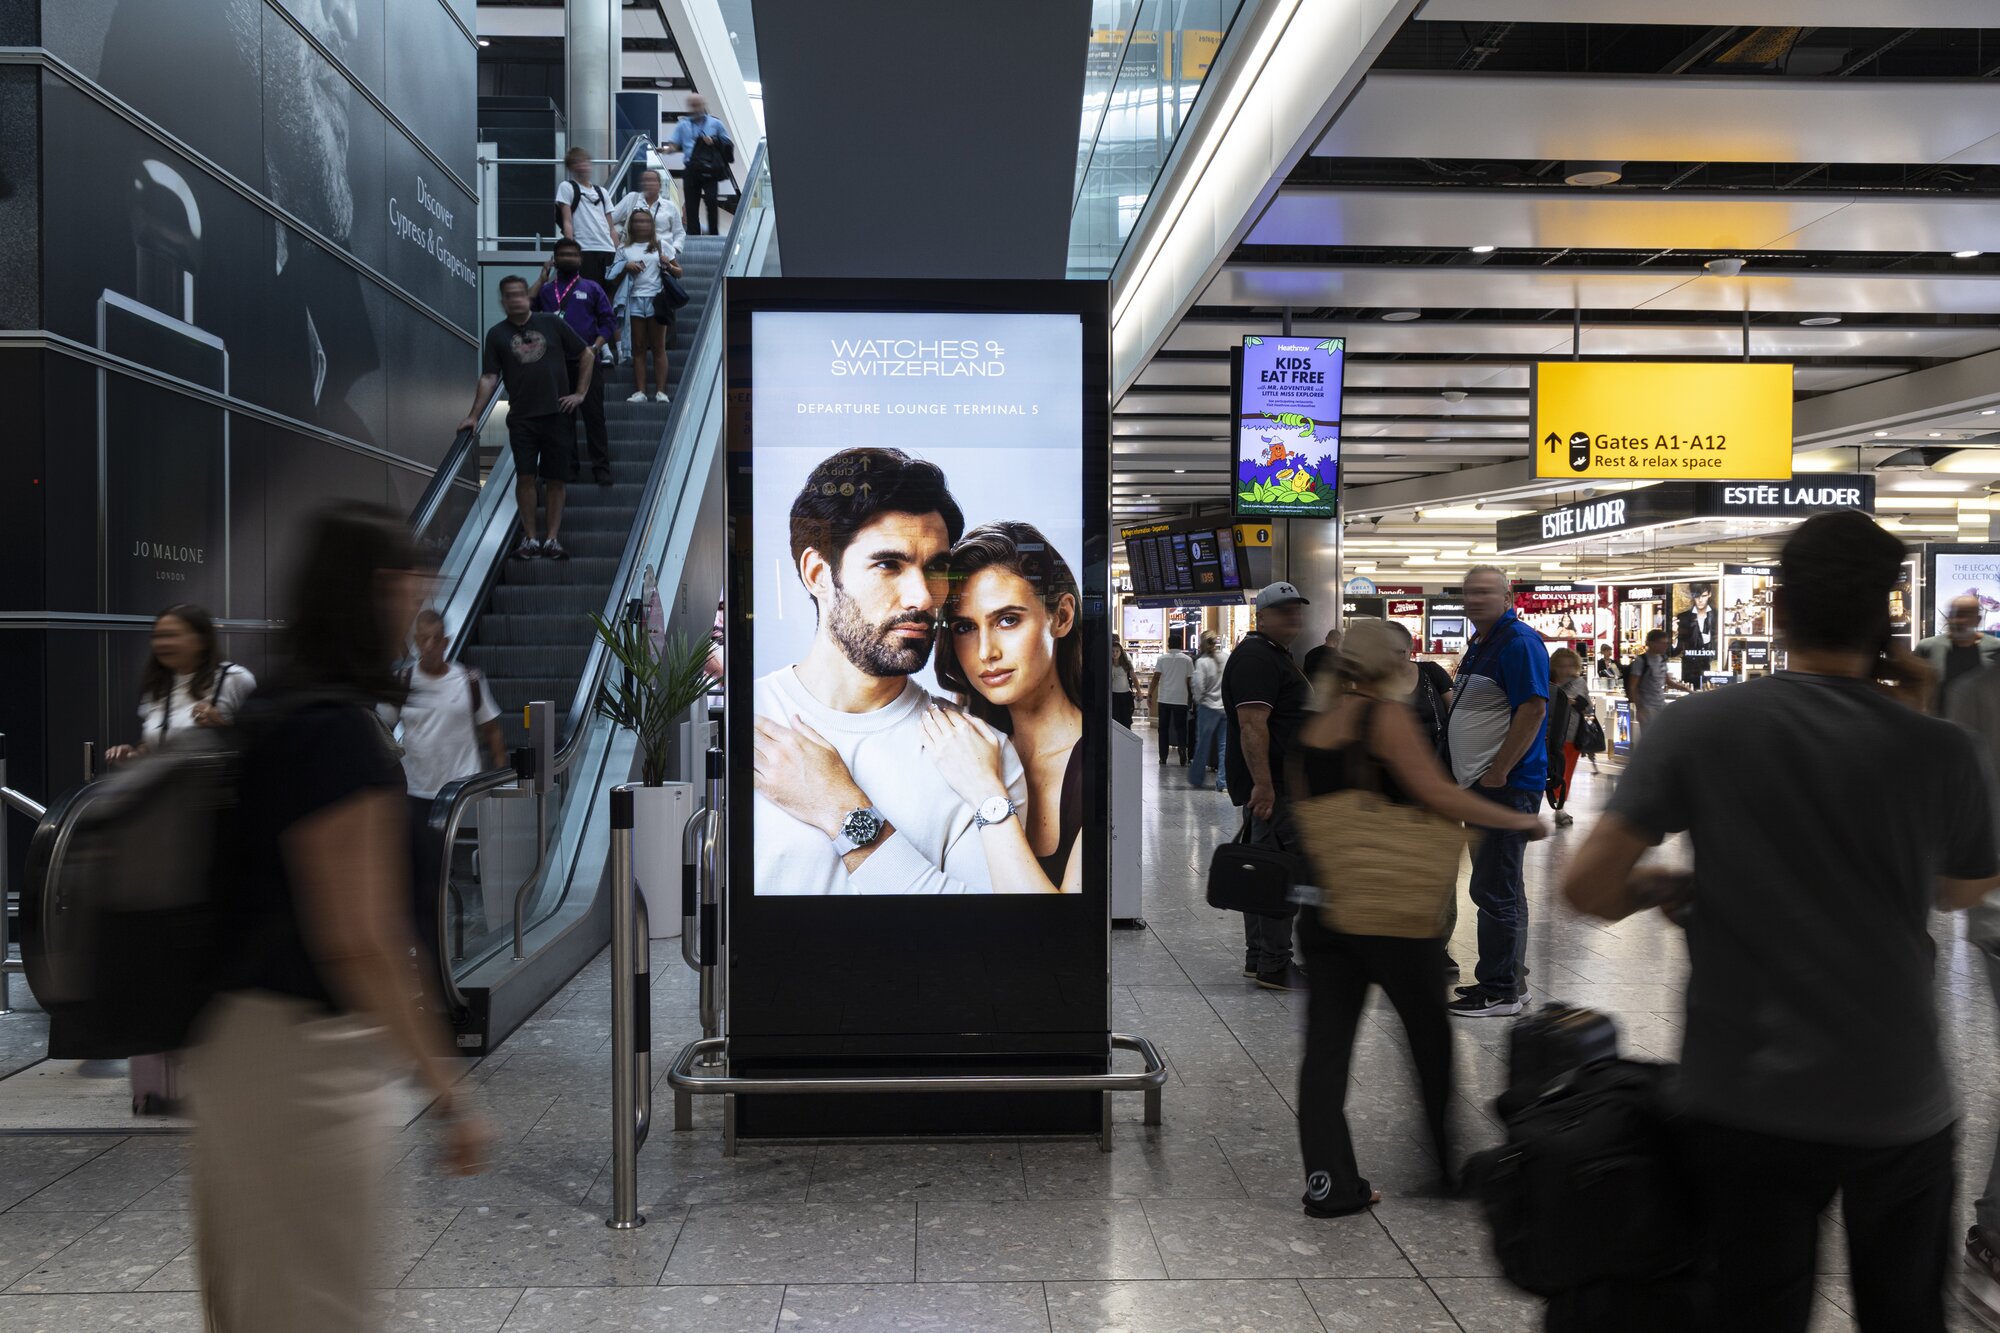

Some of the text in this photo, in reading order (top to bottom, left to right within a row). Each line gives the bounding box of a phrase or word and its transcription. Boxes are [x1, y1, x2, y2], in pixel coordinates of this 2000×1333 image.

[417, 175, 454, 230] Discover
[389, 197, 476, 287] Cypress & Grapevine
[831, 340, 979, 359] WATCHES
[831, 361, 1005, 377] SWITZERLAND
[1276, 357, 1311, 370] KIDS
[1261, 370, 1287, 383] EAT
[797, 403, 1039, 415] DEPARTURE LOUNGE TERMINAL 5
[1595, 434, 1727, 450] Gates A1-A12
[1595, 455, 1722, 470] Rest & relax space
[1784, 488, 1861, 505] LAUDER
[1576, 498, 1626, 533] LAUDER
[132, 540, 204, 564] JO MALONE
[156, 571, 185, 581] LONDON
[1954, 564, 1999, 572] THE LEGACY
